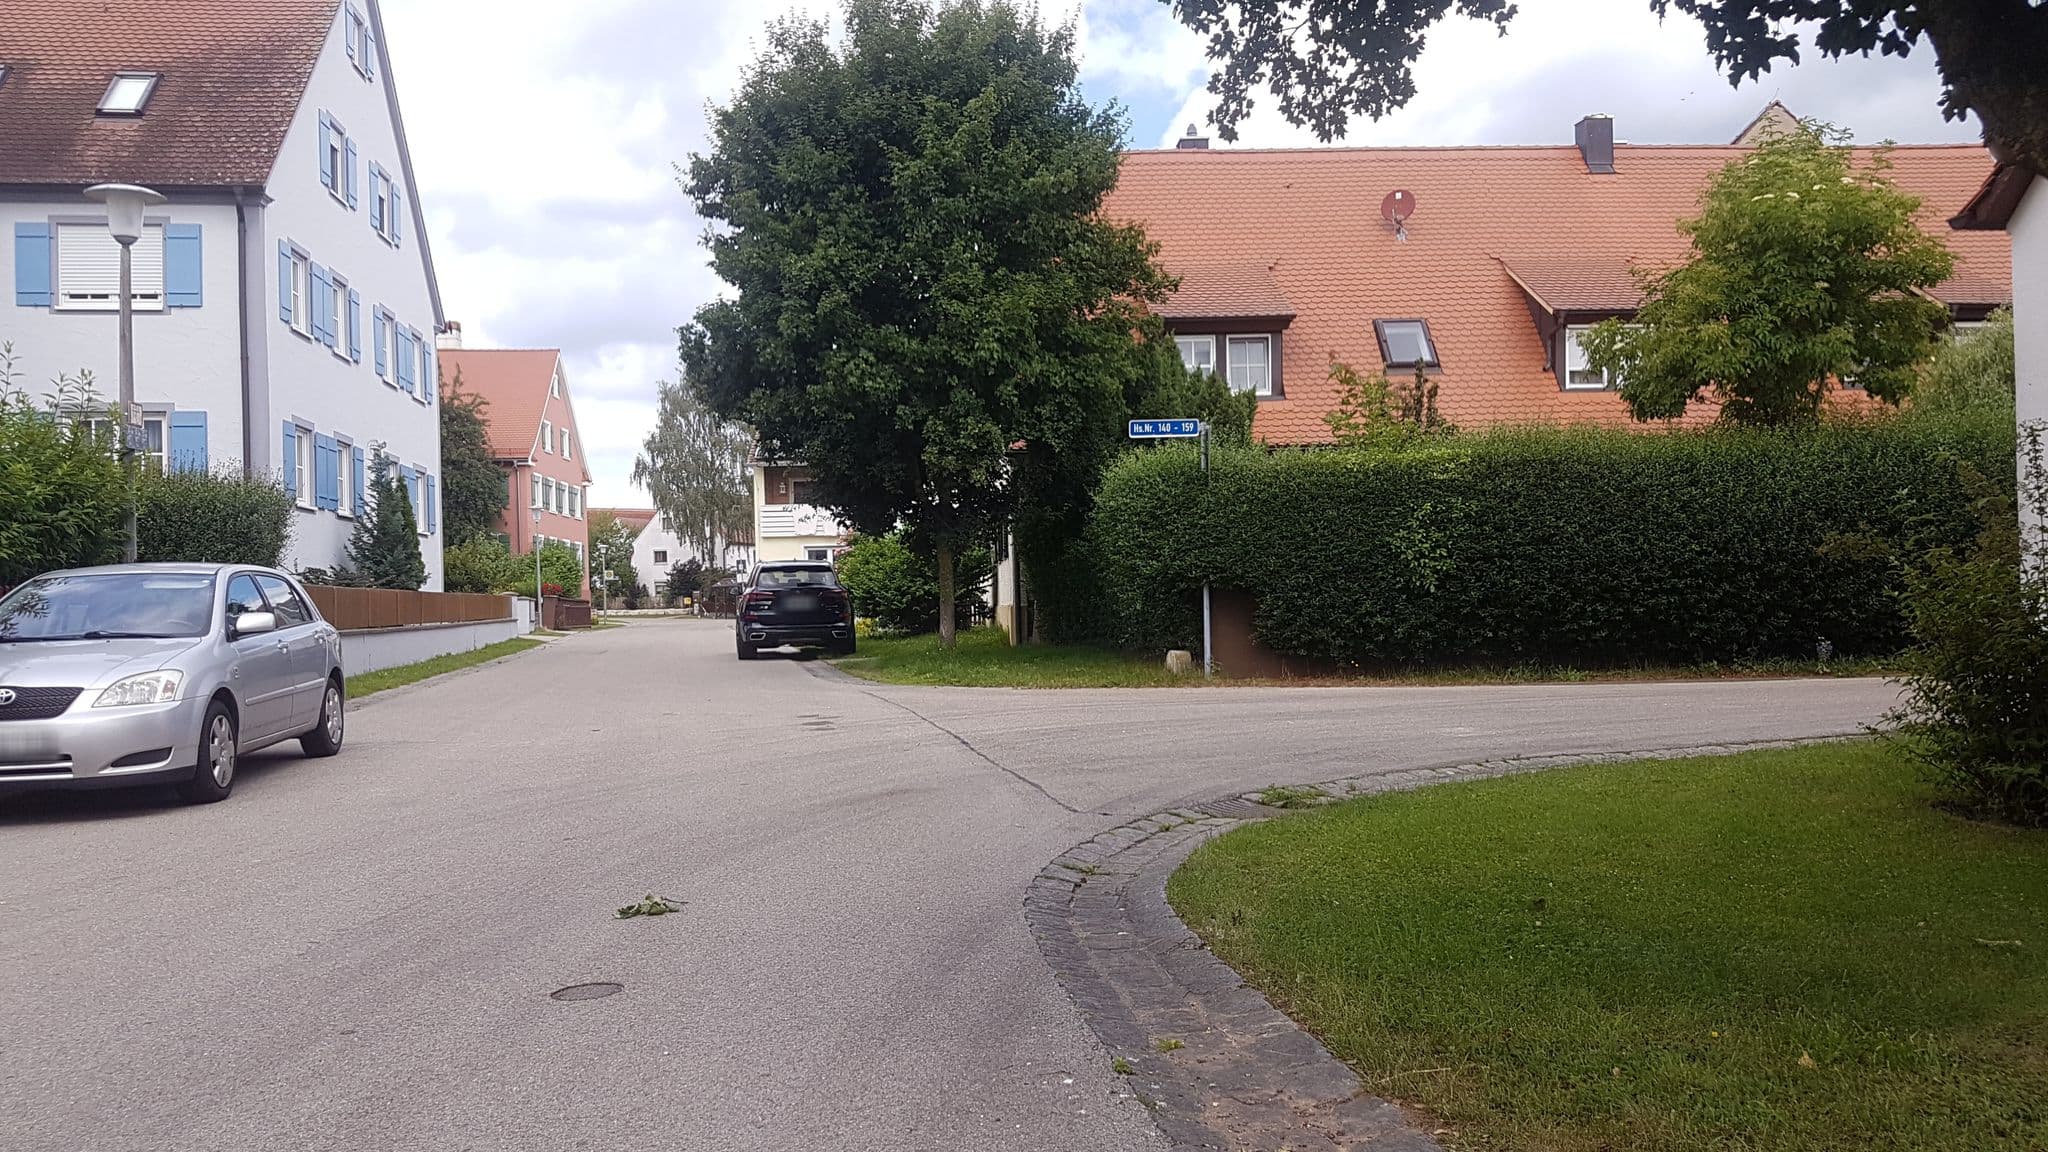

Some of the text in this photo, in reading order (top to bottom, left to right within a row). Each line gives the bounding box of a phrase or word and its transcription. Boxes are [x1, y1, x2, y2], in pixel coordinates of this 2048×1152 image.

[1133, 423, 1155, 433] Hs.Nr.
[1158, 423, 1171, 432] 140
[1181, 422, 1194, 432] 159
